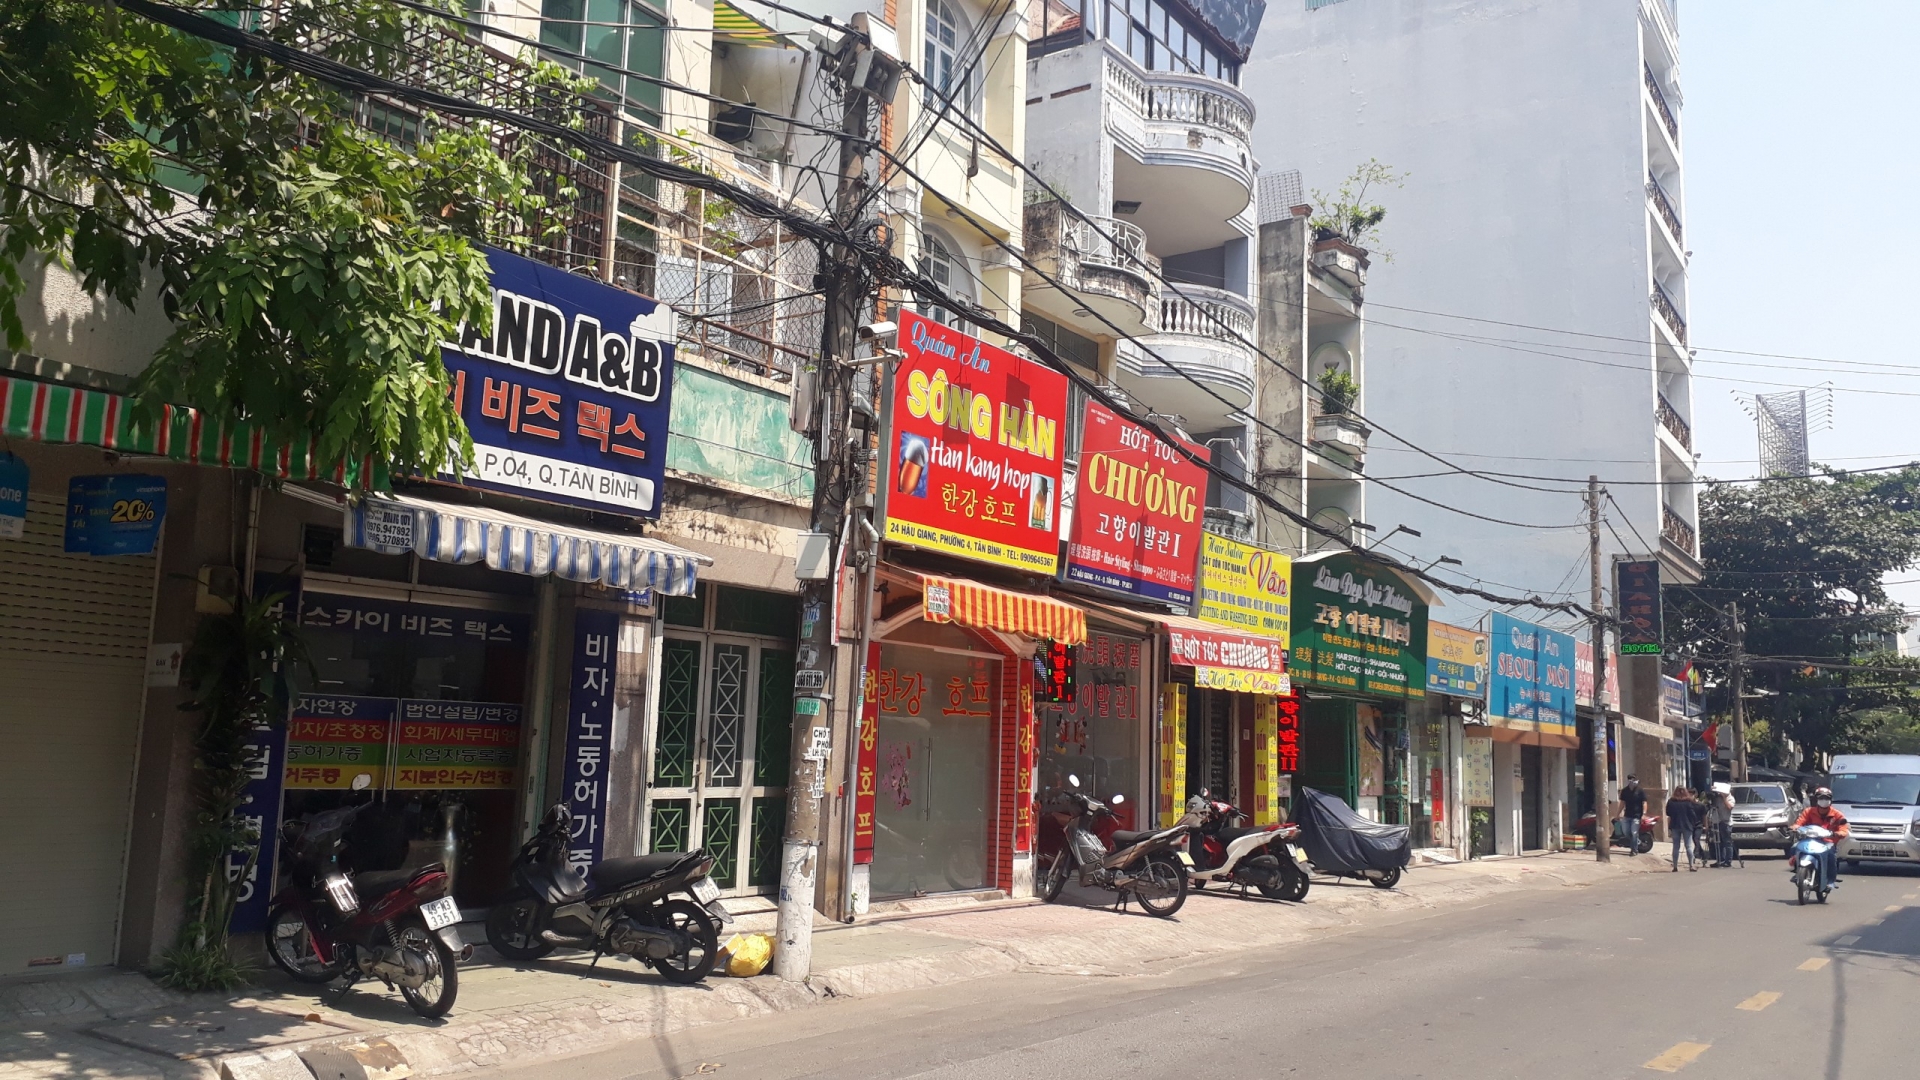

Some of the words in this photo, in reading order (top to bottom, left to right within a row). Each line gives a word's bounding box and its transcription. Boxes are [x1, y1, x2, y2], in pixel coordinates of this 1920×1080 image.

[568, 318, 660, 399] A&B
[911, 320, 956, 361] Quán
[959, 340, 990, 374] Ăn
[481, 377, 561, 440] 비즈
[577, 400, 646, 459] 택스
[906, 368, 992, 441] SÔNG
[998, 399, 1057, 461] HÀN
[1119, 424, 1150, 453] HỚT
[928, 437, 963, 467] Han
[965, 450, 1001, 491] kang
[1003, 465, 1031, 499] hop
[599, 472, 639, 501] BÌNH
[941, 482, 978, 518] 한강
[980, 495, 1016, 527] 호프
[1088, 452, 1197, 524] CHƯƠNG
[110, 499, 155, 523] 20%
[890, 522, 900, 534] 24
[901, 523, 915, 539] HẬU
[916, 528, 938, 544] GIANG,
[939, 532, 965, 549] PHƯỜNG
[974, 538, 987, 554] TÂN
[988, 541, 1002, 557] BÌNH
[1006, 548, 1019, 561] TEL:
[304, 606, 390, 633] 스카이
[401, 614, 454, 637] 비즈
[464, 620, 512, 642] 택스
[1202, 636, 1219, 662] TÓC
[1220, 639, 1270, 670] CHƯƠNG
[1621, 643, 1661, 653] HOTEL
[1497, 652, 1541, 684] SEOUL
[1546, 662, 1571, 690] MỚI
[879, 667, 927, 717] 한강
[942, 676, 991, 717] 호프
[406, 704, 518, 722] 법인설립/변경
[404, 725, 517, 743] 회계/세무대행
[405, 748, 512, 763] 사업자등록증
[399, 769, 514, 785] 지분인수/변경
[431, 910, 456, 927] 3351
